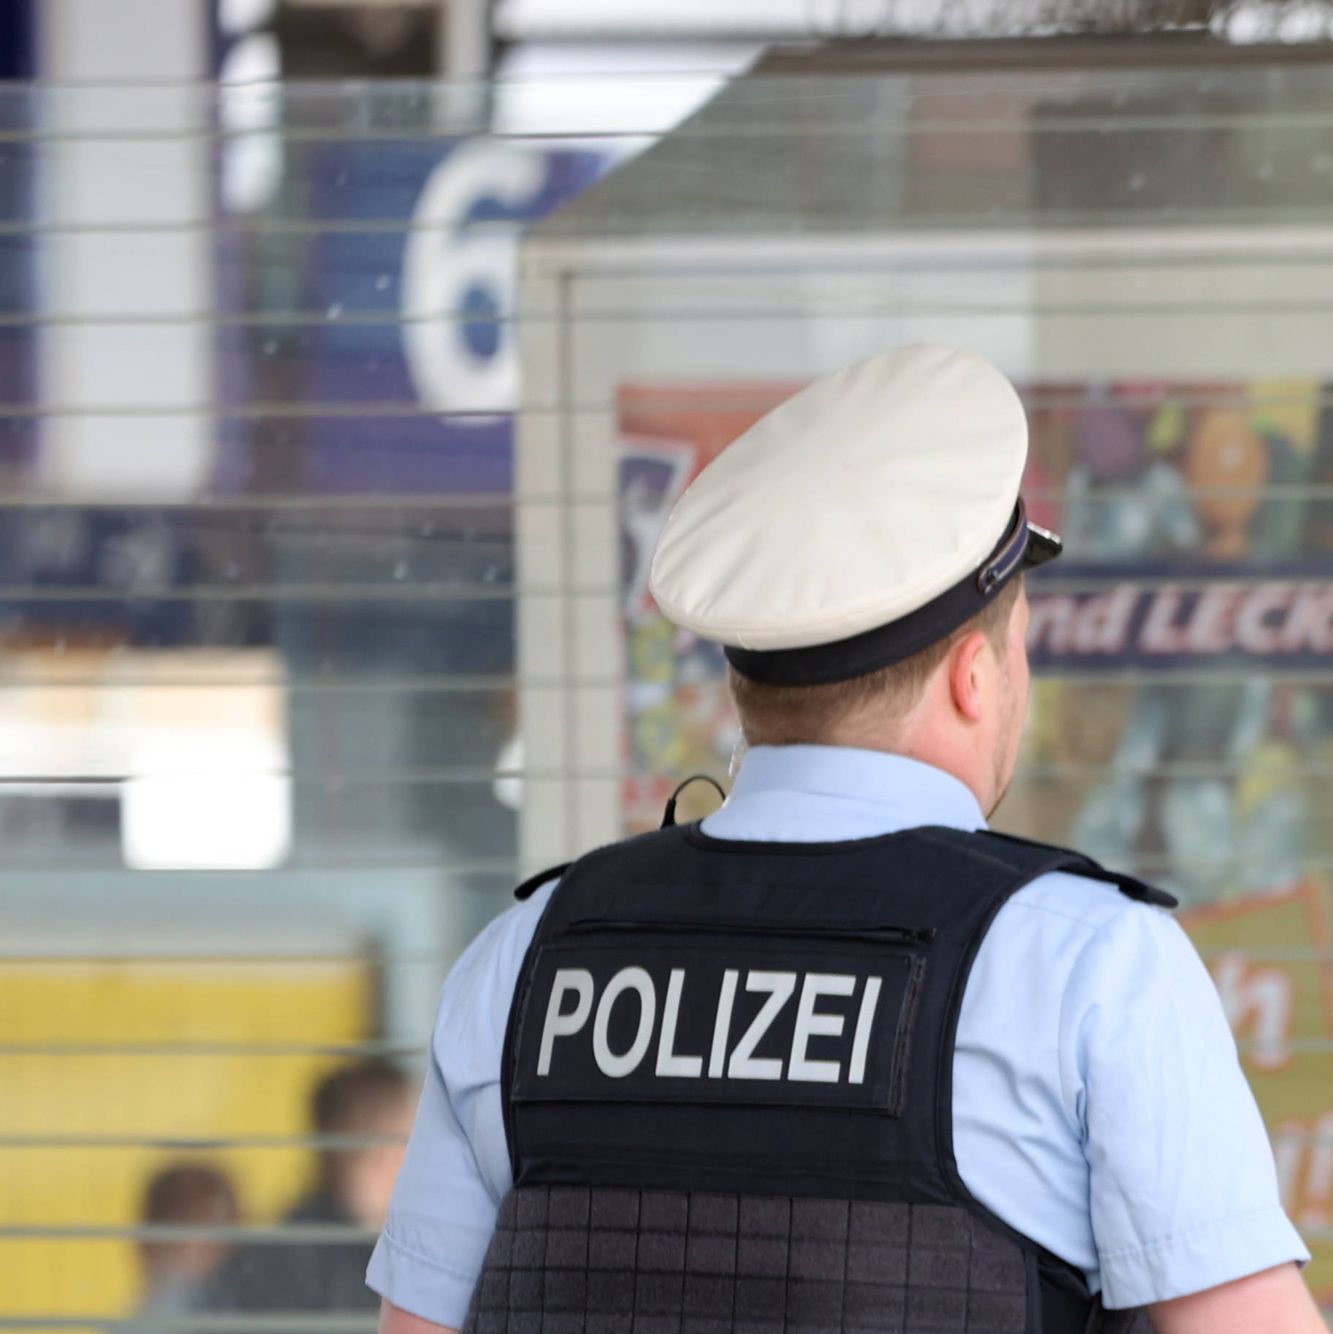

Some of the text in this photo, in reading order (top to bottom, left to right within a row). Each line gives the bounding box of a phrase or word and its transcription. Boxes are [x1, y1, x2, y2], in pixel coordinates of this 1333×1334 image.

[400, 138, 548, 426] 6
[1028, 580, 1136, 656] nd
[536, 965, 883, 1085] POLIZEI
